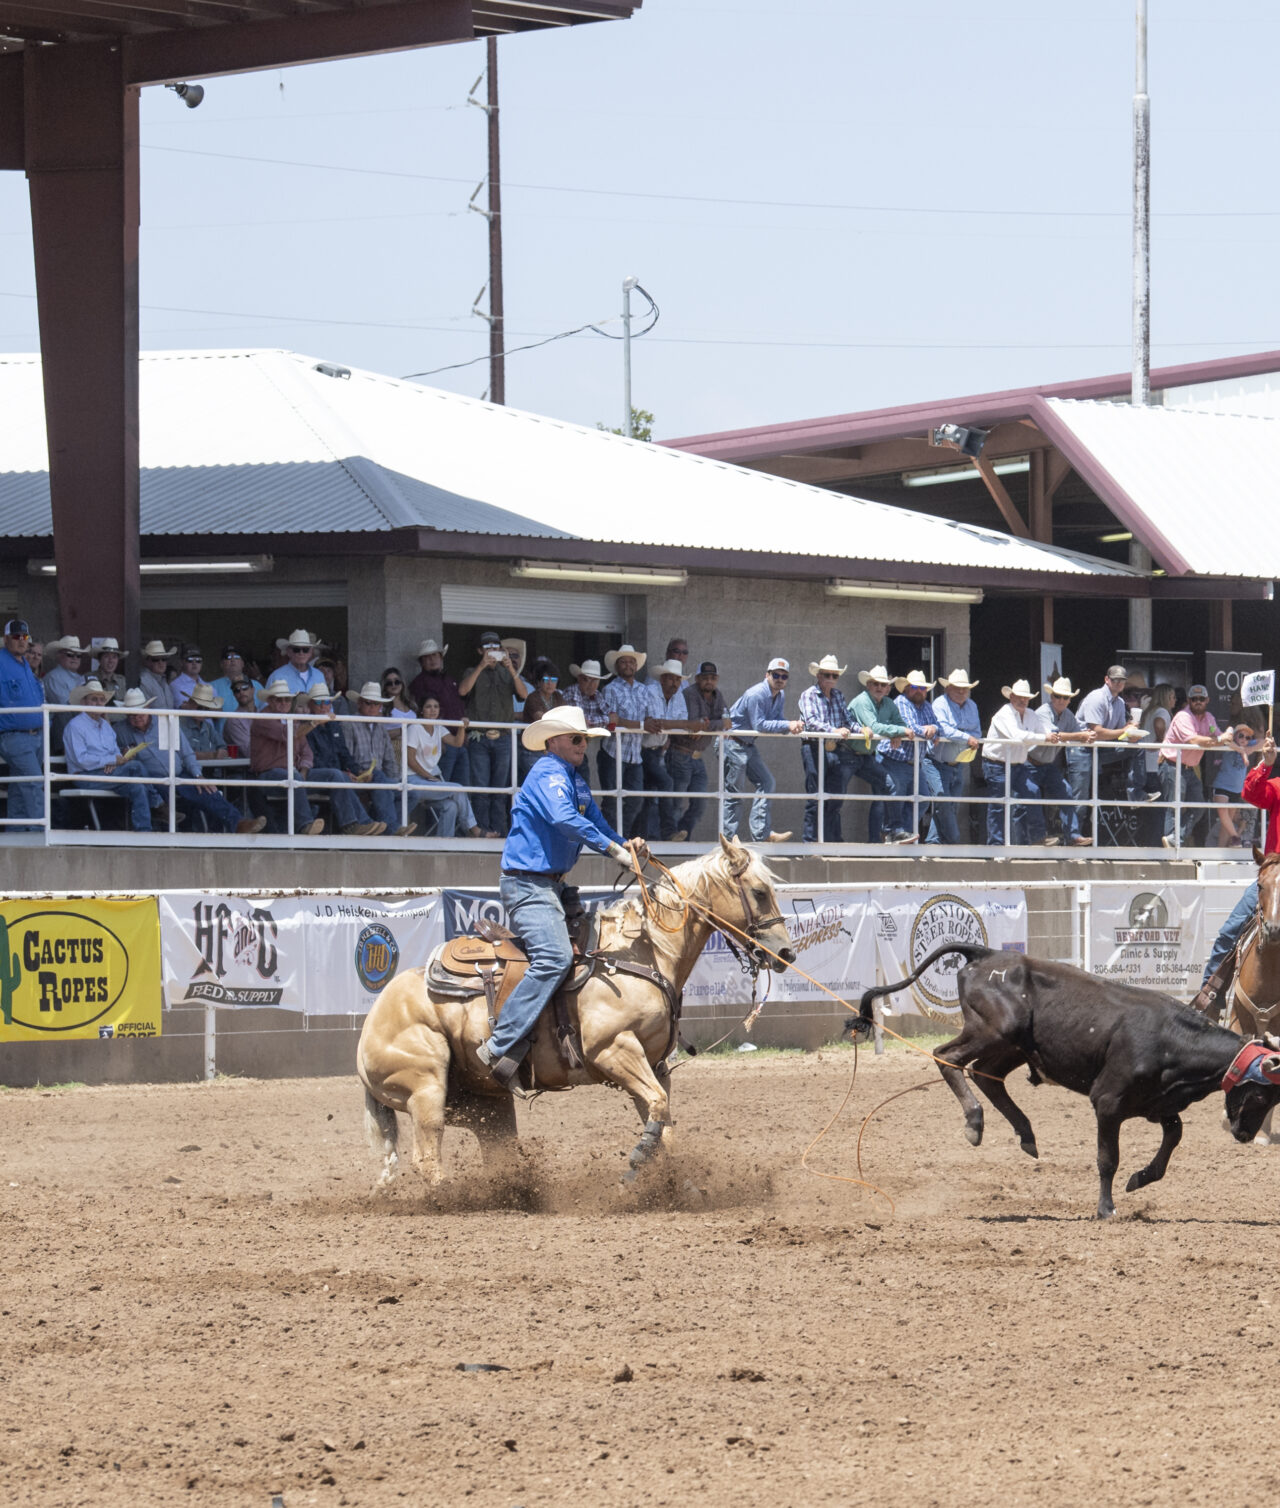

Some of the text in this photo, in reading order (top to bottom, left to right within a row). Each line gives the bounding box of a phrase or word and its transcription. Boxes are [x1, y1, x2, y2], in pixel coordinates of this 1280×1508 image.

[922, 904, 975, 931] SENIOR
[798, 921, 843, 954] EXPRESS
[1120, 948, 1178, 960] Clinic & Supply
[236, 990, 278, 1003] SUPPLY
[117, 1022, 156, 1032] OFFICIAL
